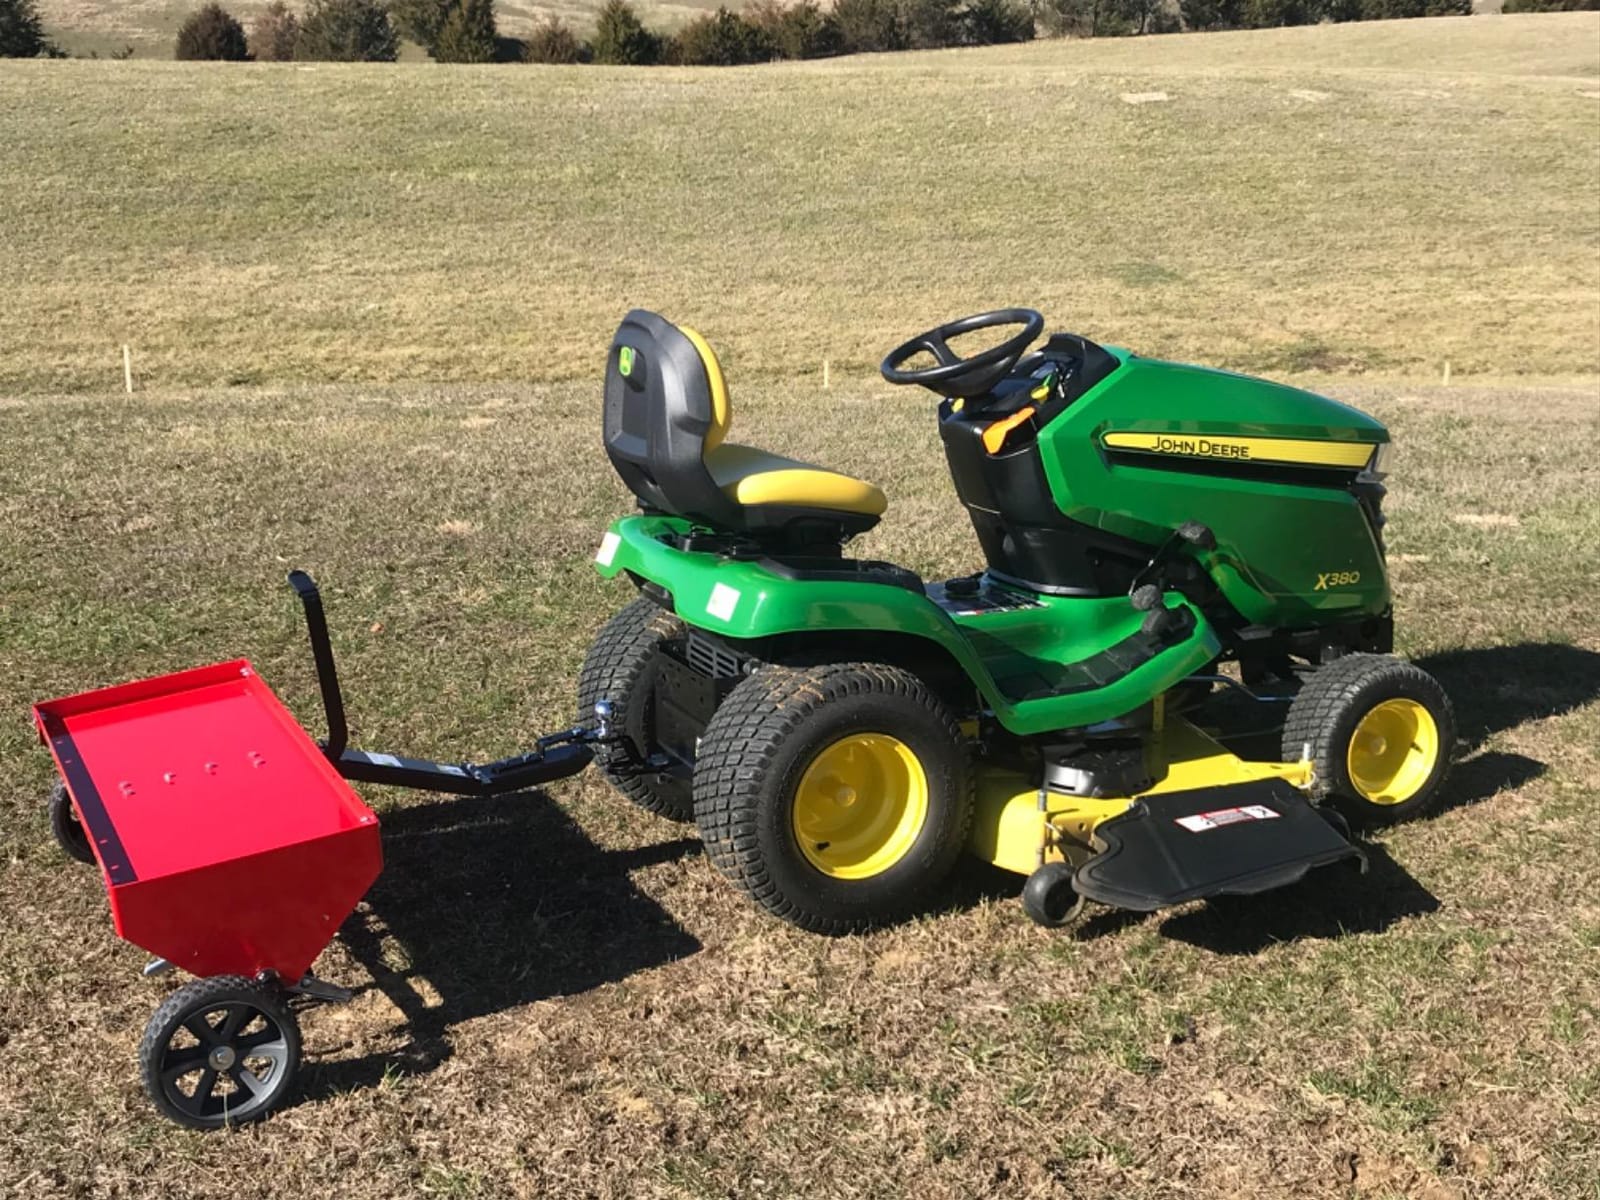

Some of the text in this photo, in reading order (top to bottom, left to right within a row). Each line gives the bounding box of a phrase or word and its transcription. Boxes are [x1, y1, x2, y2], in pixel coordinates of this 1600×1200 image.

[1152, 436, 1250, 457] JOHN DEERE
[1313, 571, 1360, 590] X380
